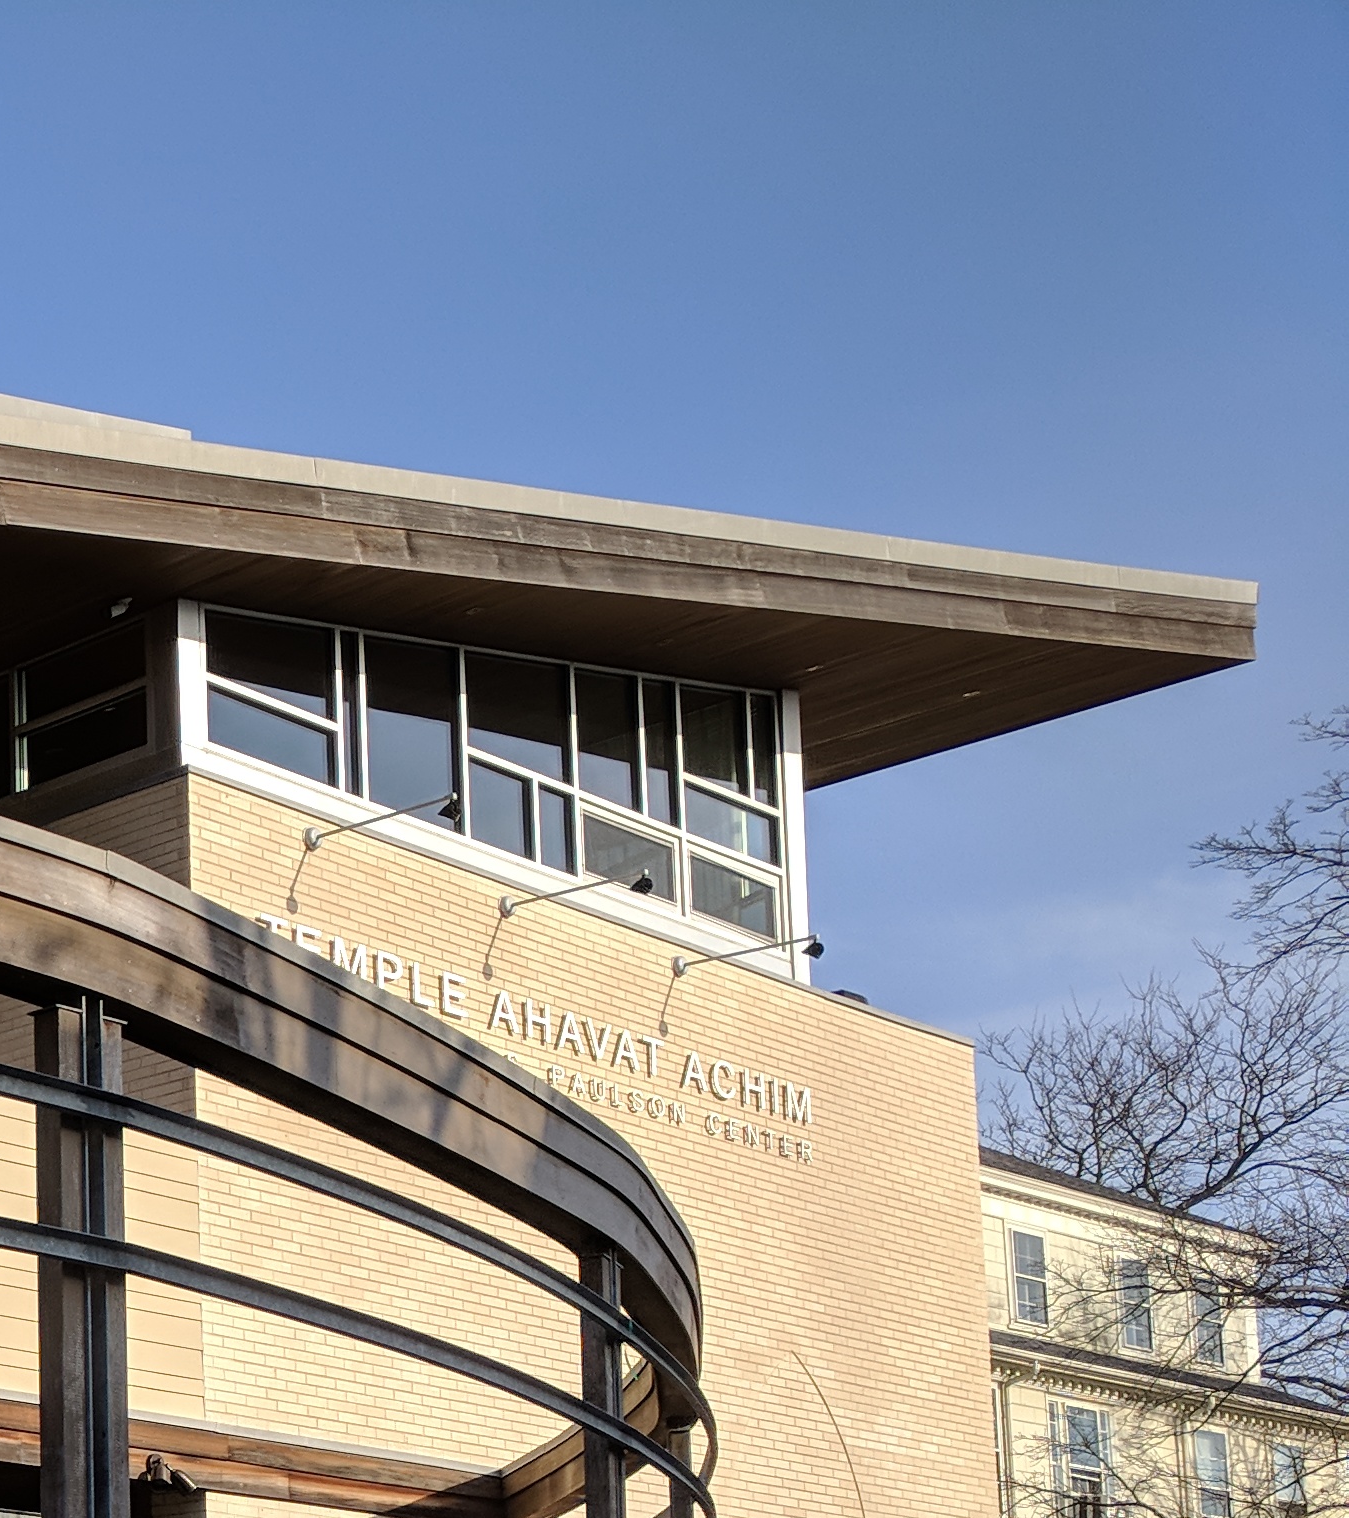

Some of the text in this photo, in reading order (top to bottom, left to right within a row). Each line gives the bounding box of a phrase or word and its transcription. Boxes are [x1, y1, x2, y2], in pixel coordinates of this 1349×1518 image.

[490, 989, 665, 1077] AHAVAT
[681, 1050, 813, 1125] ACHIM
[549, 1064, 813, 1164] PAULSON CENTER
